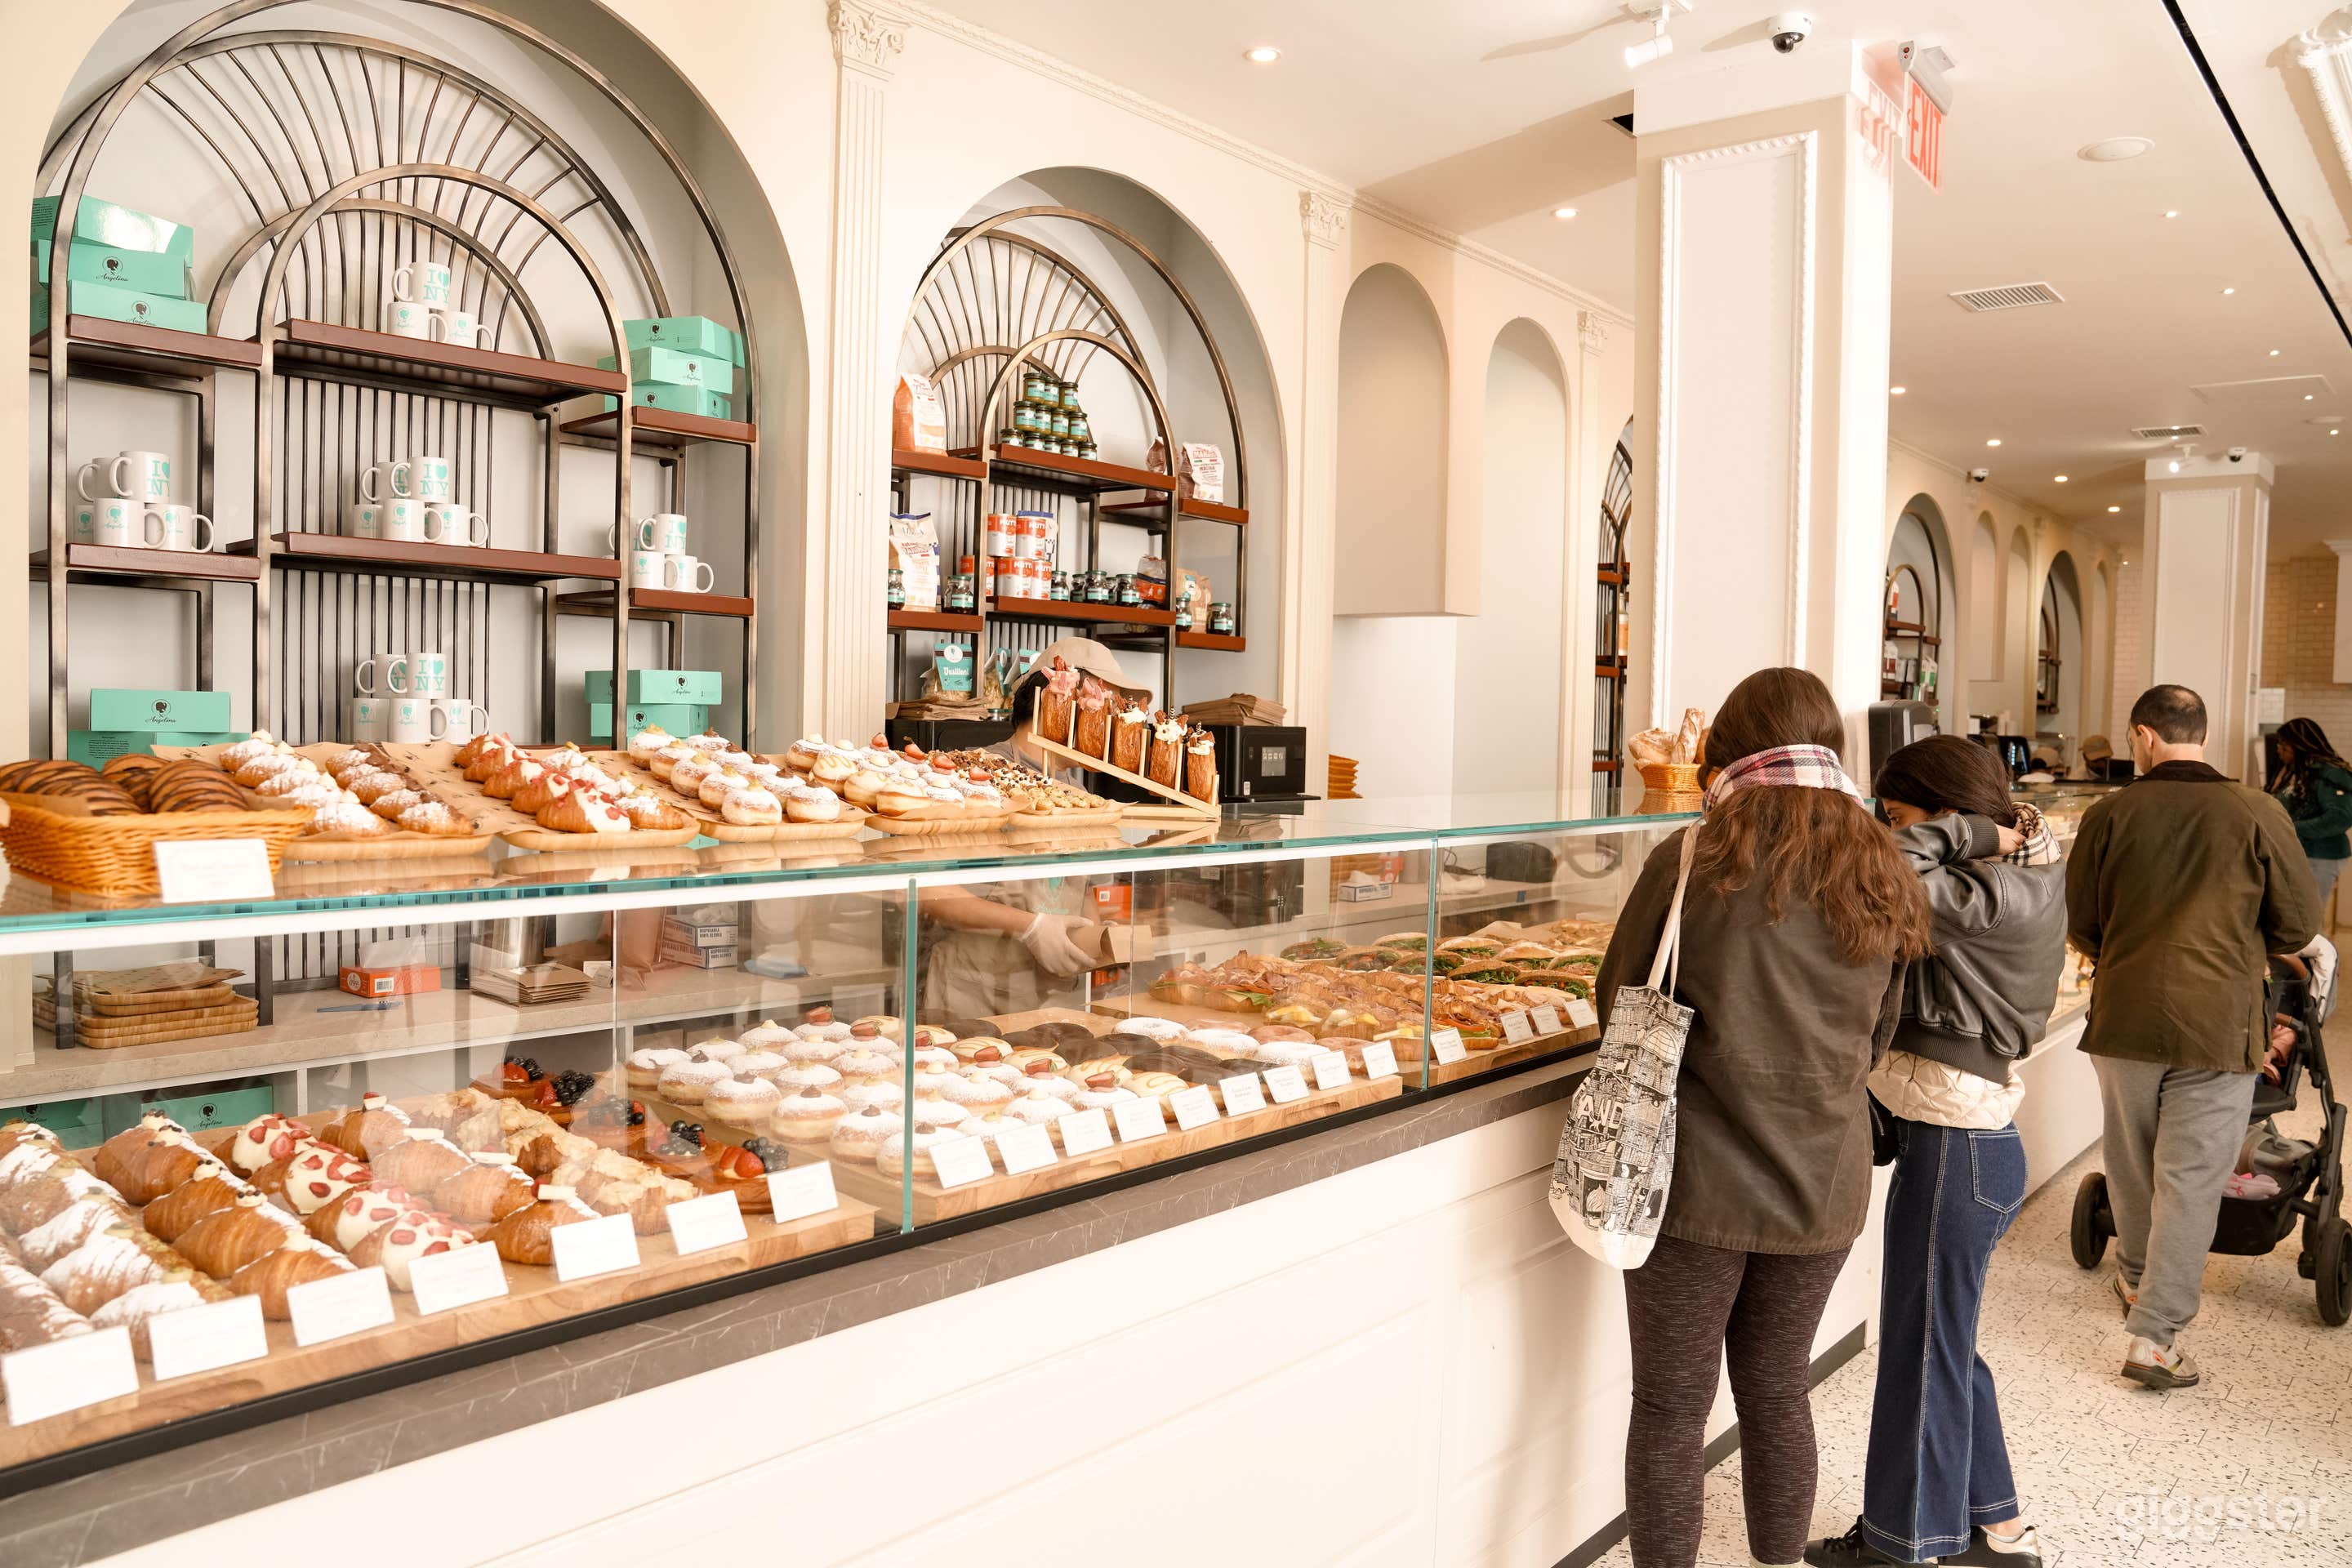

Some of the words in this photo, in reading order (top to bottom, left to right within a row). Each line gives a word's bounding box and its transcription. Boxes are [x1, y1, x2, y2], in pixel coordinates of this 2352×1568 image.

[1910, 80, 1942, 188] EXIT
[420, 480, 449, 497] NY
[415, 676, 445, 692] NY
[145, 715, 177, 724] Angelina
[194, 1120, 223, 1129] Angelina
